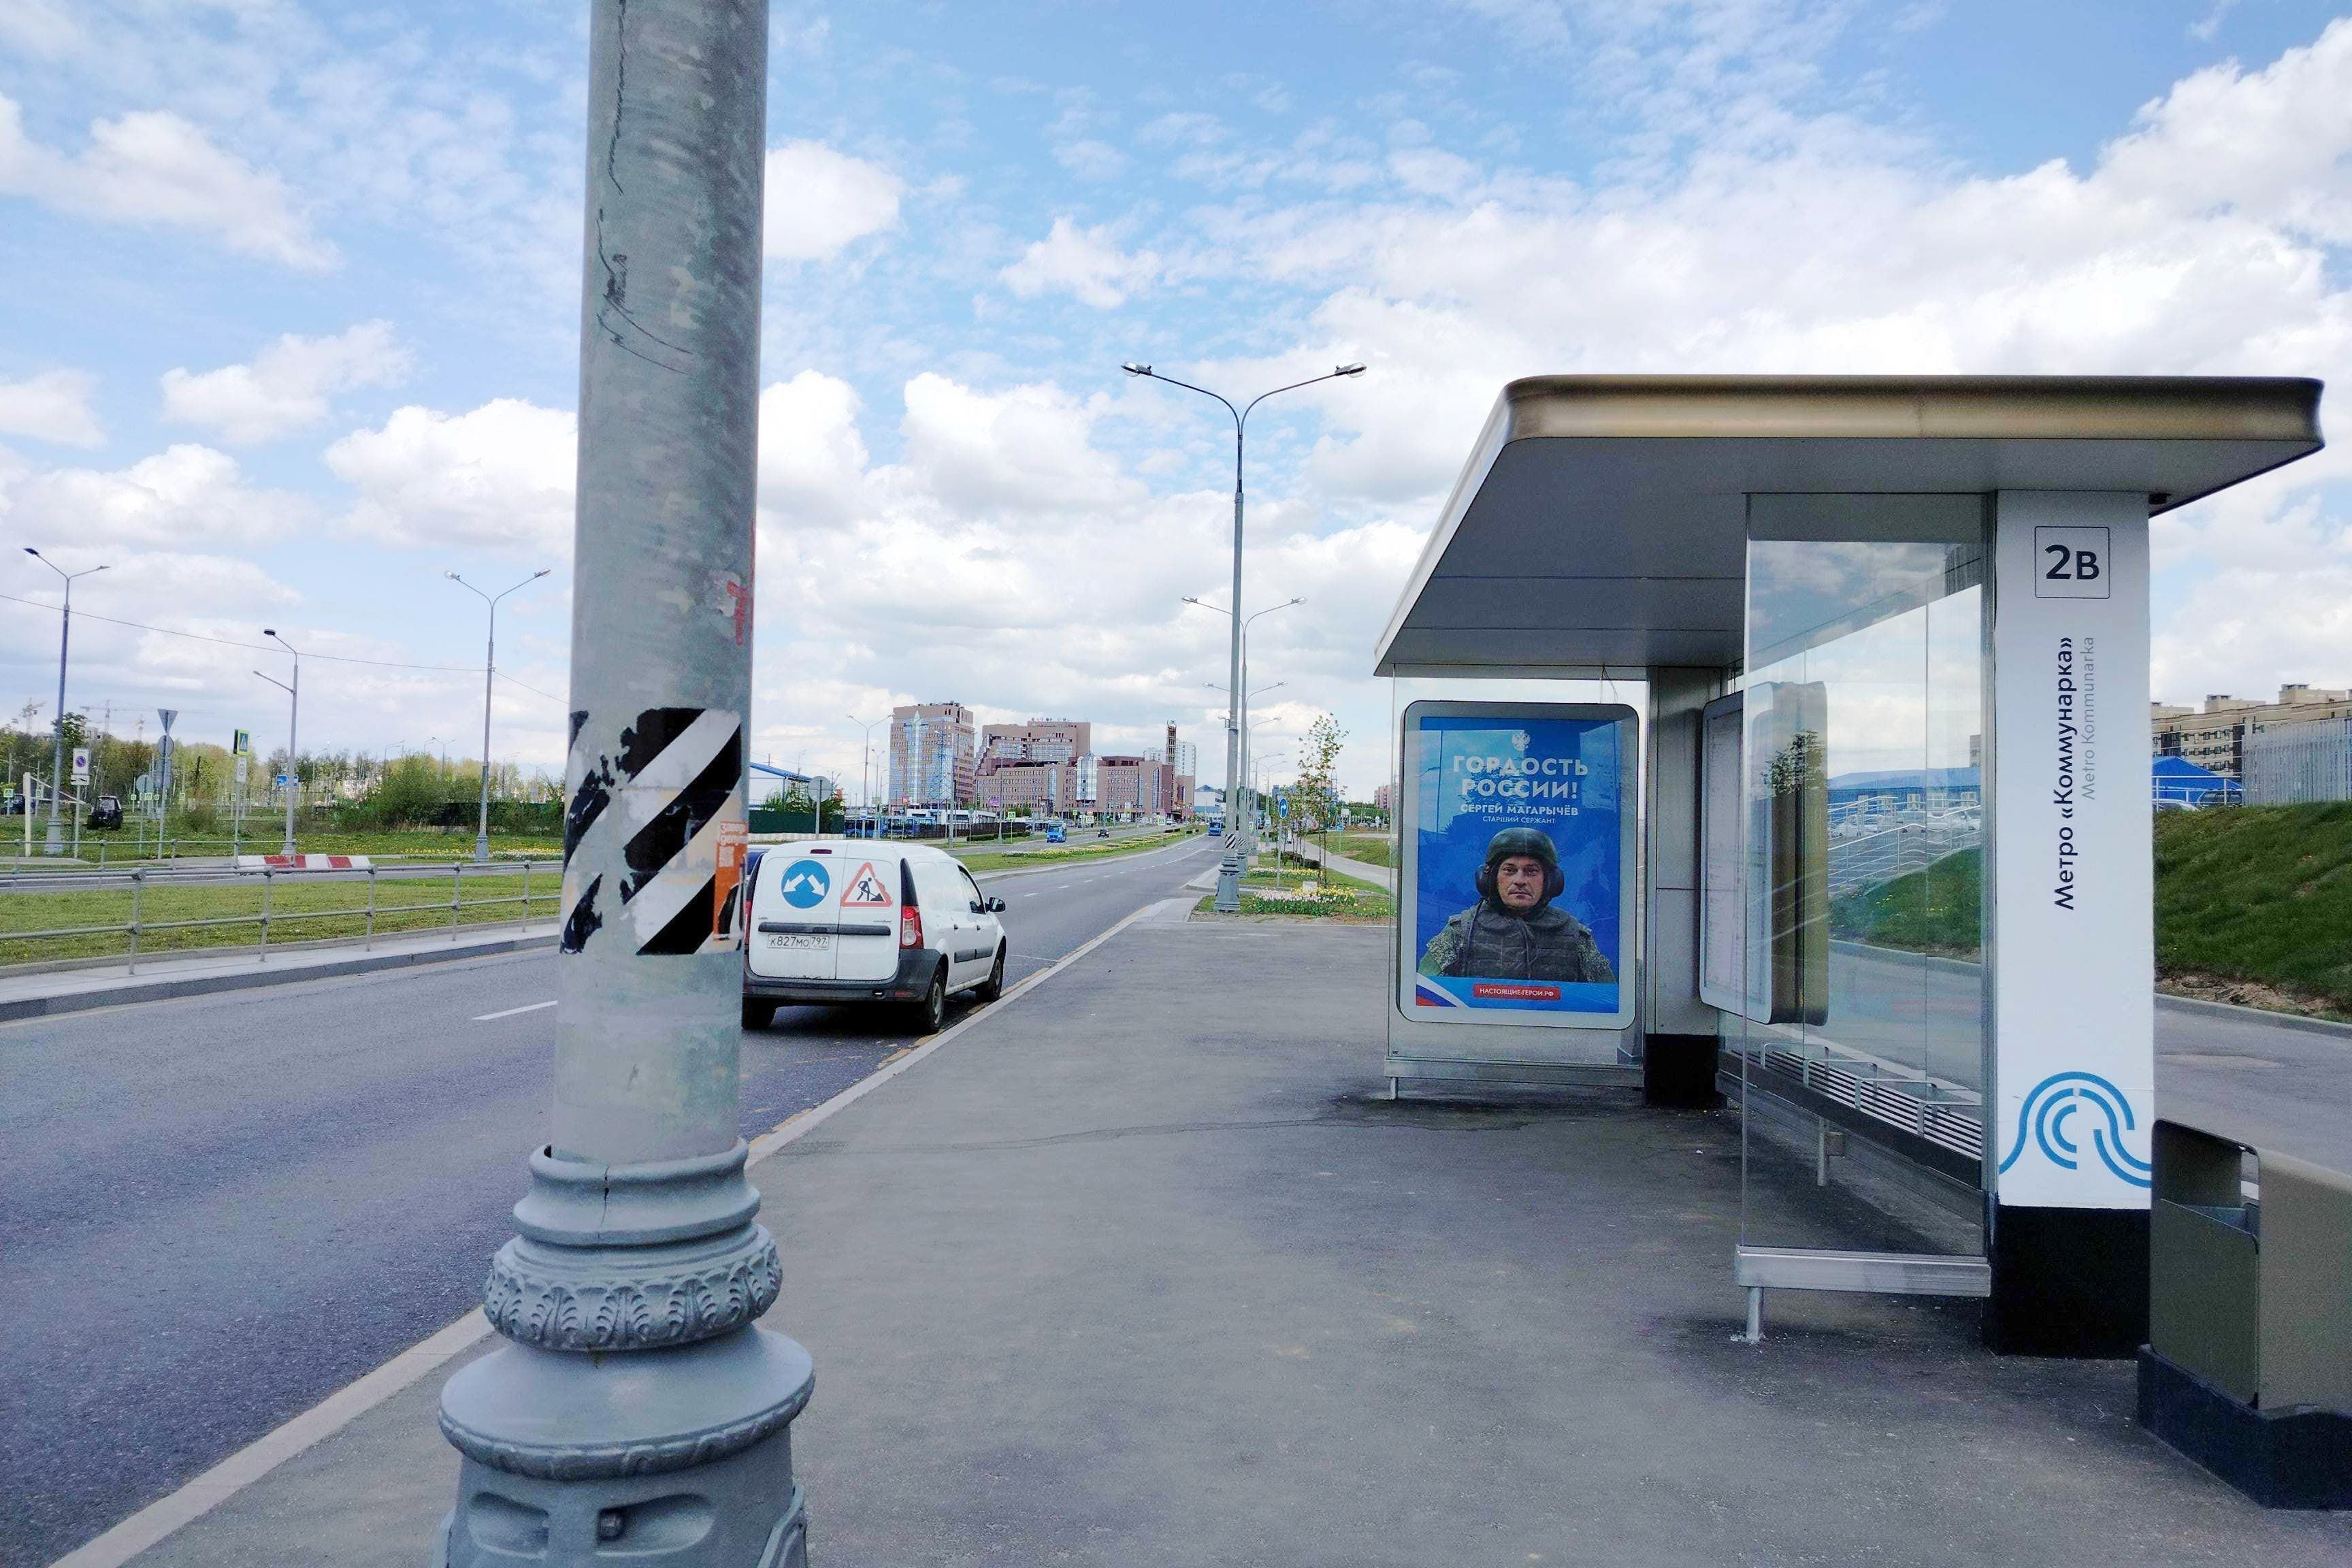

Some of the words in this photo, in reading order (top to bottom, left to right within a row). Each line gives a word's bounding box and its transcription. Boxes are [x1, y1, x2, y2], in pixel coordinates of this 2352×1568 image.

[2045, 544, 2100, 580] 2В
[2080, 637, 2095, 747] Kommunarka
[2053, 637, 2078, 819] «Коммунарка»
[1453, 755, 1588, 777] ГОРДОСТЬ
[2081, 749, 2096, 800] Metro
[1461, 779, 1578, 799] РОССИИ!
[1460, 803, 1503, 813] СЕРГЕЙ
[1507, 805, 1578, 815] МАГАРЫЧЁВ
[2054, 826, 2078, 911] Метро
[1480, 988, 1554, 996] НАСТОЯЩИЕ-ГЕРОИ.РФ
